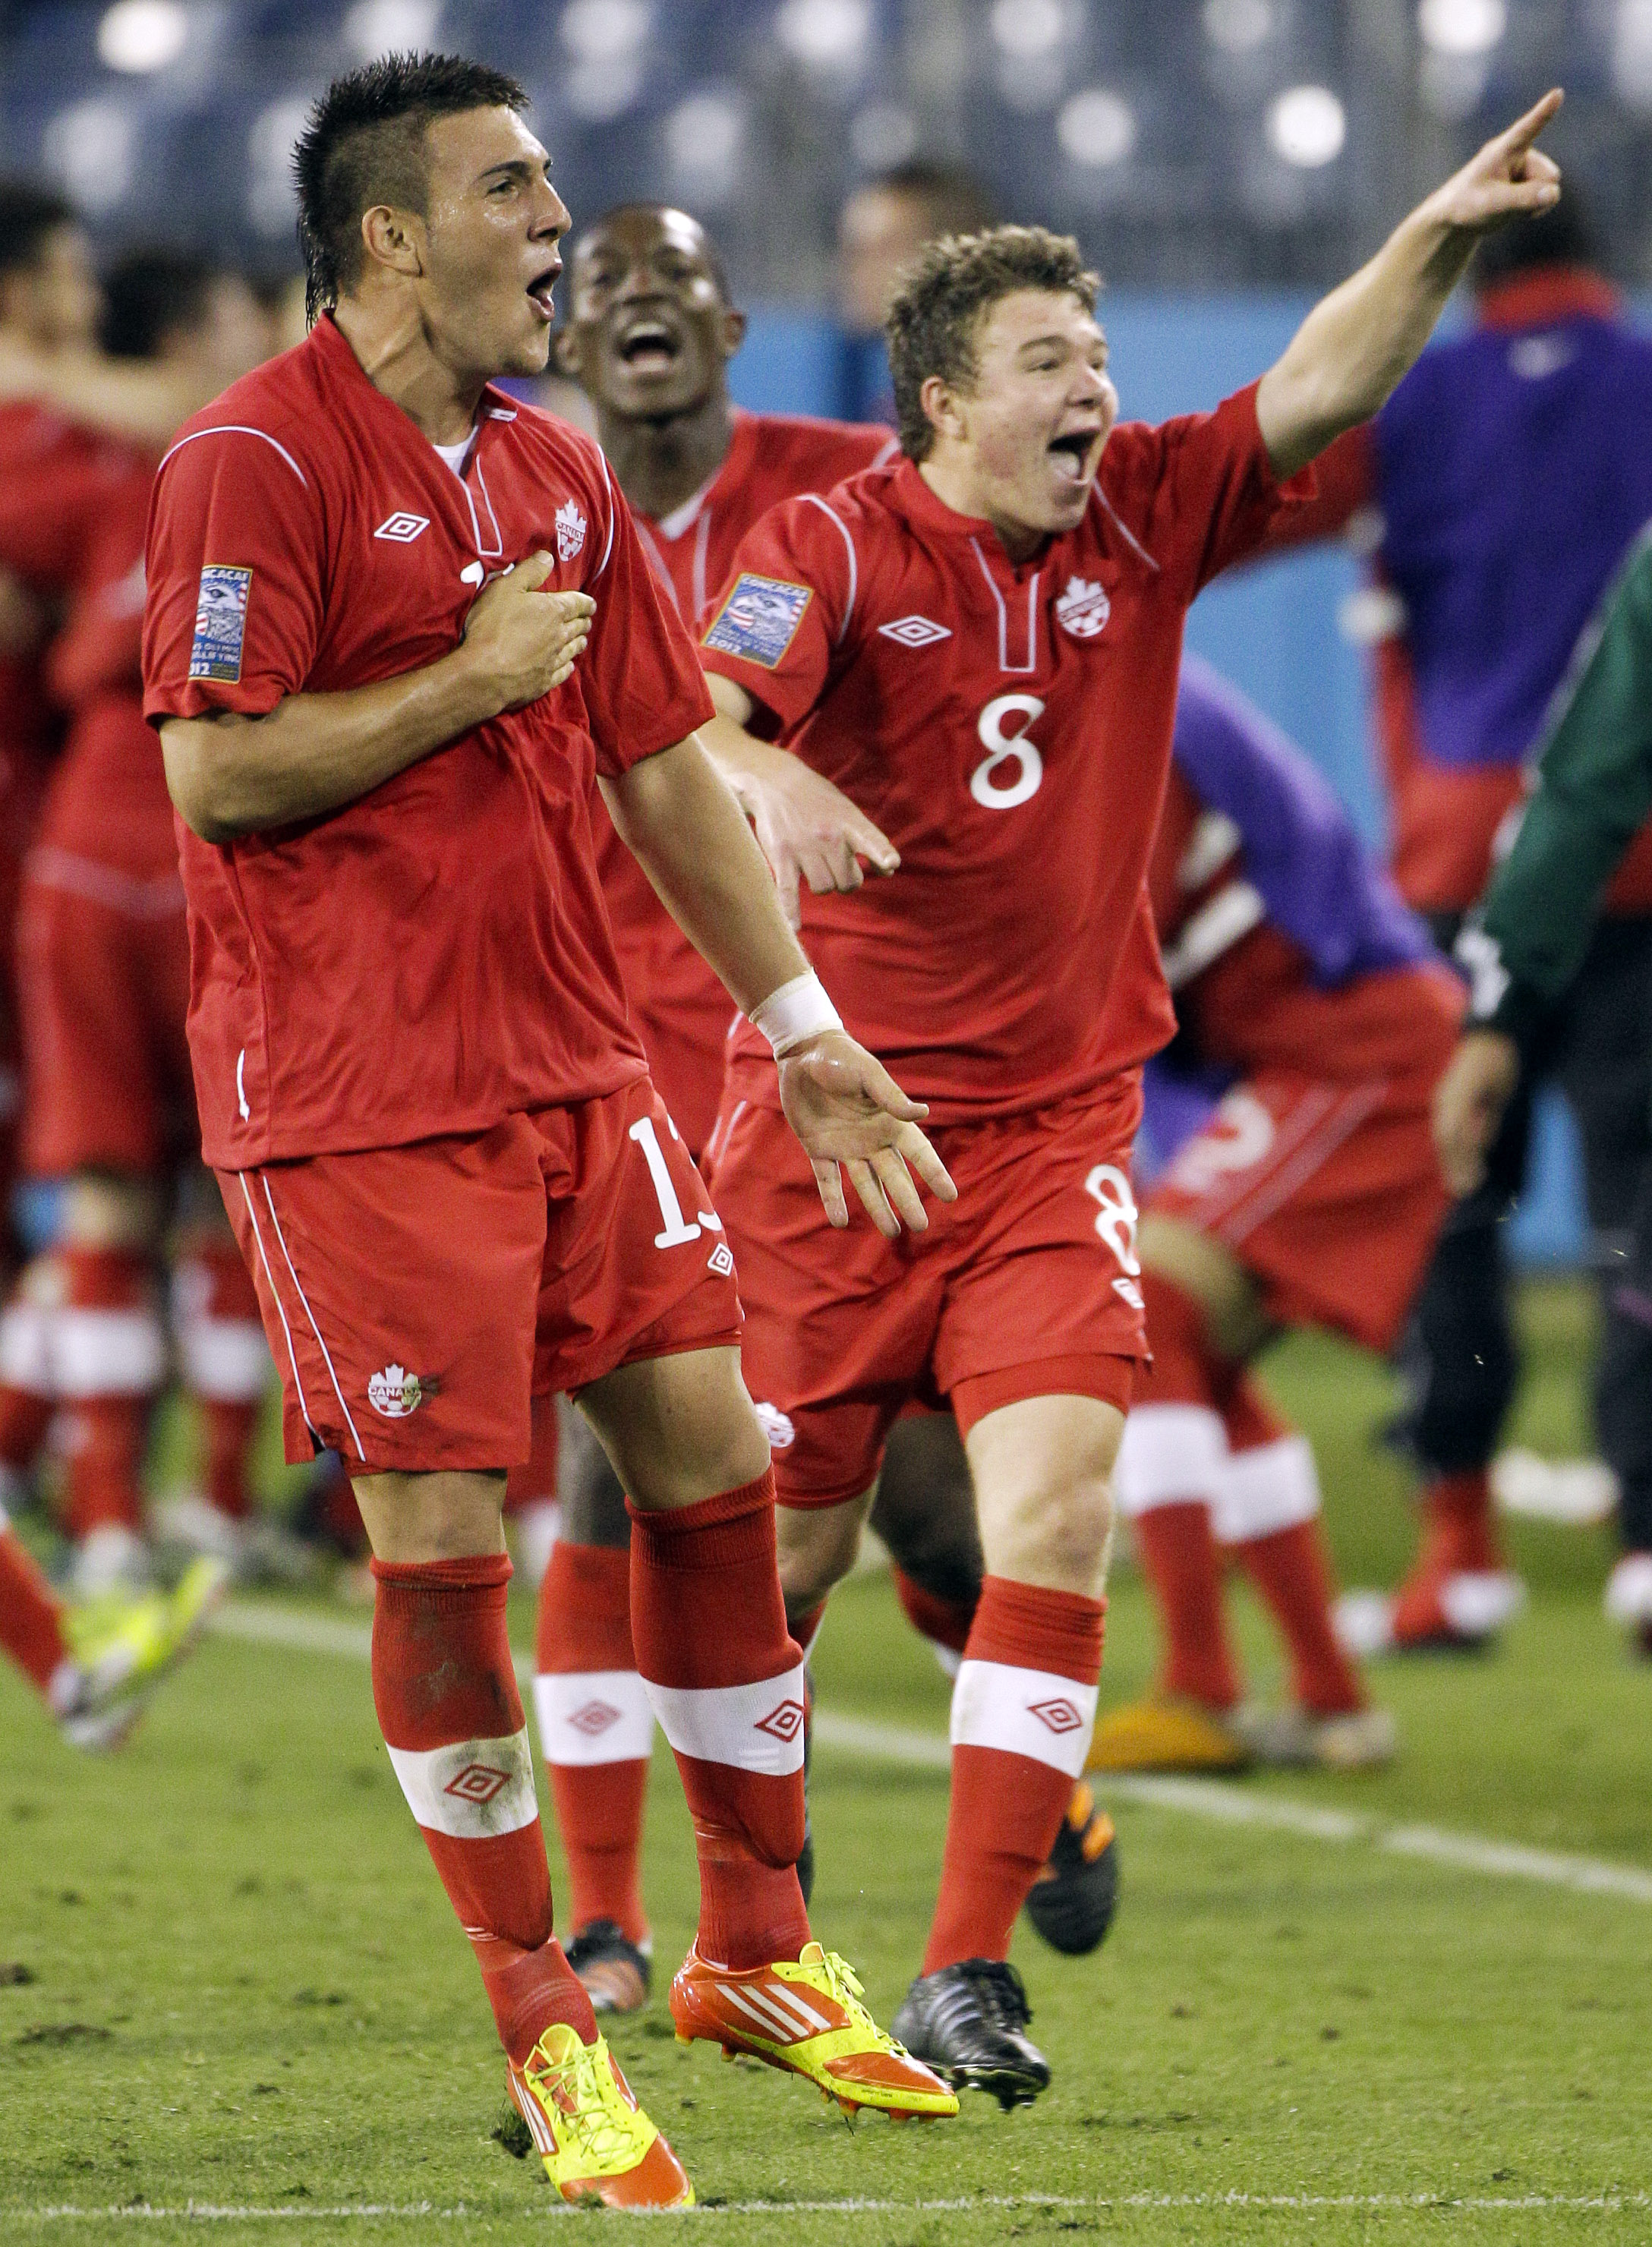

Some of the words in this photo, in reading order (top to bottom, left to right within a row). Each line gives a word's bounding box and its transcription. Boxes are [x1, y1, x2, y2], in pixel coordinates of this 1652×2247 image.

[556, 522, 585, 544] CANADA
[970, 694, 1045, 810] 8
[629, 1113, 723, 1250] 1
[1085, 1163, 1141, 1276] 8
